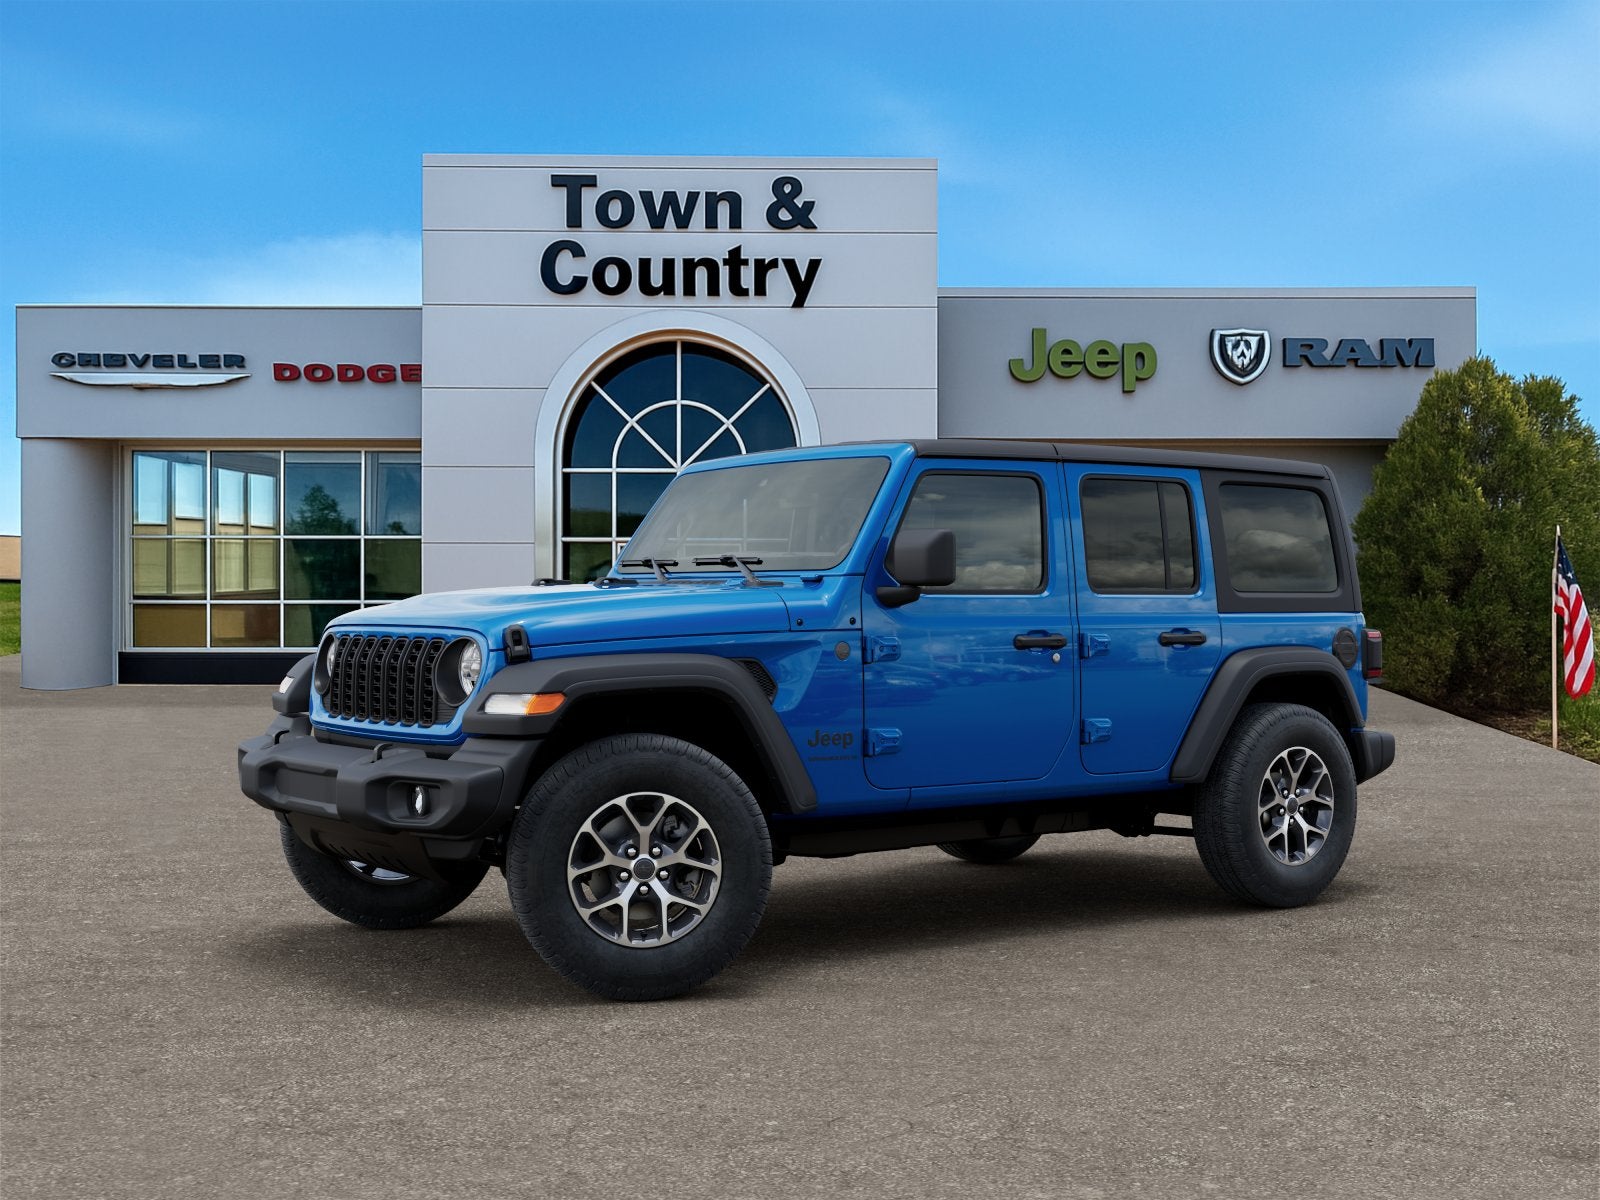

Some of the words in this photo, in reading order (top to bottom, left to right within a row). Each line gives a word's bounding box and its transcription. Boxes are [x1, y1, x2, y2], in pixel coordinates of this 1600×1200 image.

[550, 174, 743, 229] Town
[765, 175, 818, 230] &
[540, 239, 823, 308] Country
[273, 362, 422, 383] DODGE
[1008, 327, 1158, 393] Jeep
[1282, 337, 1436, 368] RAM
[807, 729, 854, 749] Jeep
